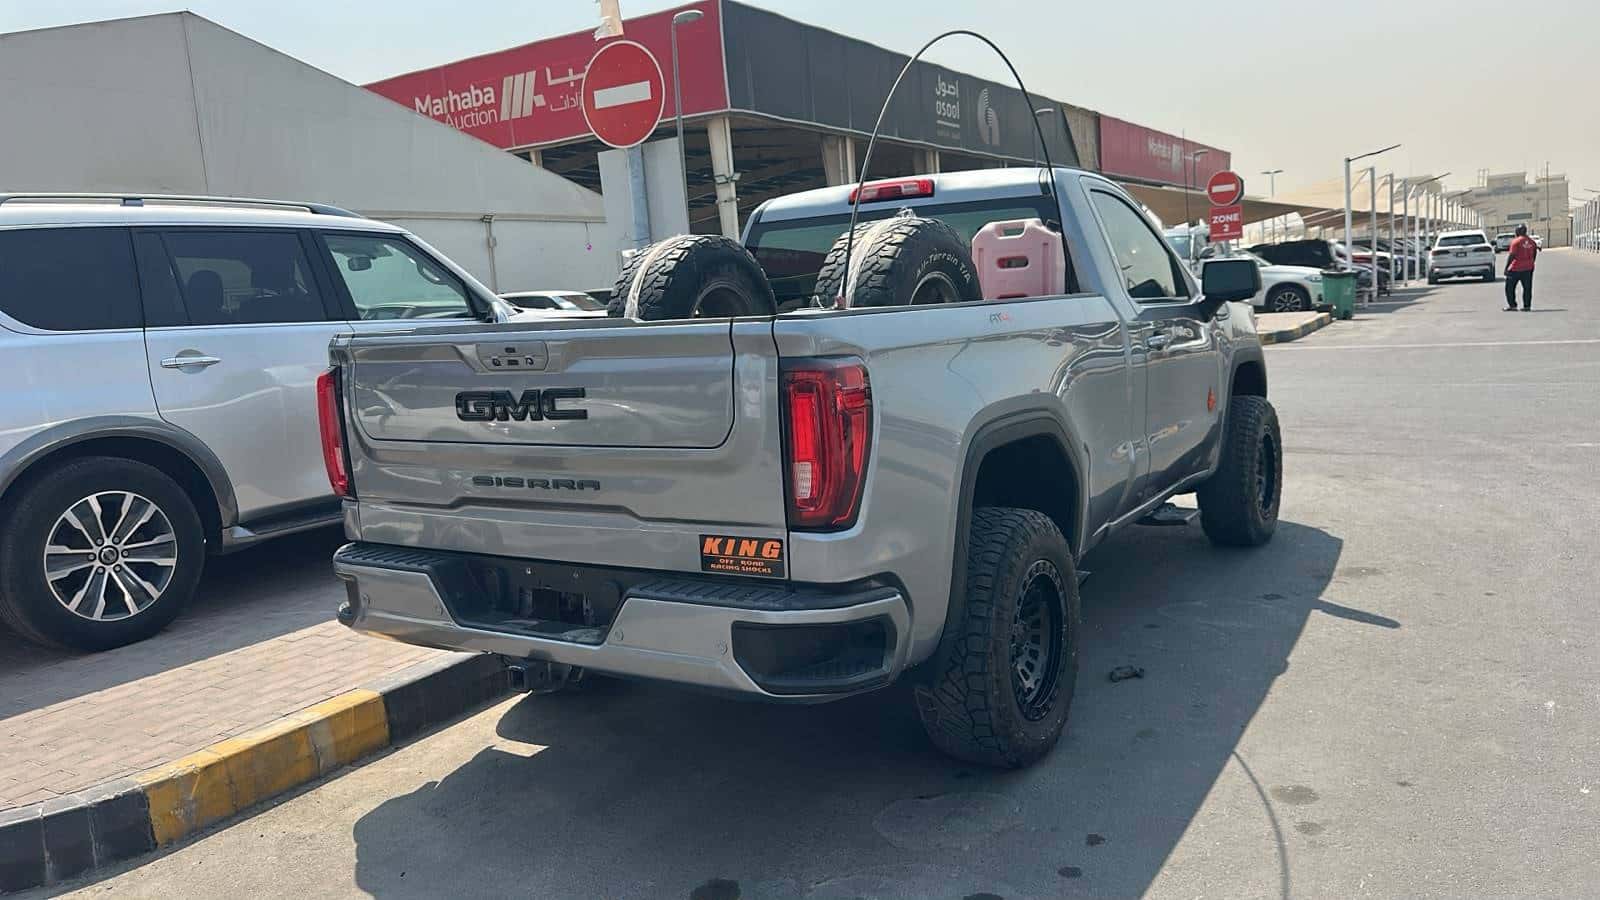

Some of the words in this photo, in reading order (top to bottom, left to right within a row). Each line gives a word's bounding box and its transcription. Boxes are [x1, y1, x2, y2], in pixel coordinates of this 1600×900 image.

[414, 84, 496, 117] Marhaba
[446, 108, 498, 129] Auction
[1212, 212, 1240, 224] ZONE
[455, 387, 588, 422] GMC
[472, 475, 601, 491] SIERRA
[703, 537, 781, 558] KING
[711, 563, 740, 571] RACING
[741, 565, 772, 574] SHOCKS
